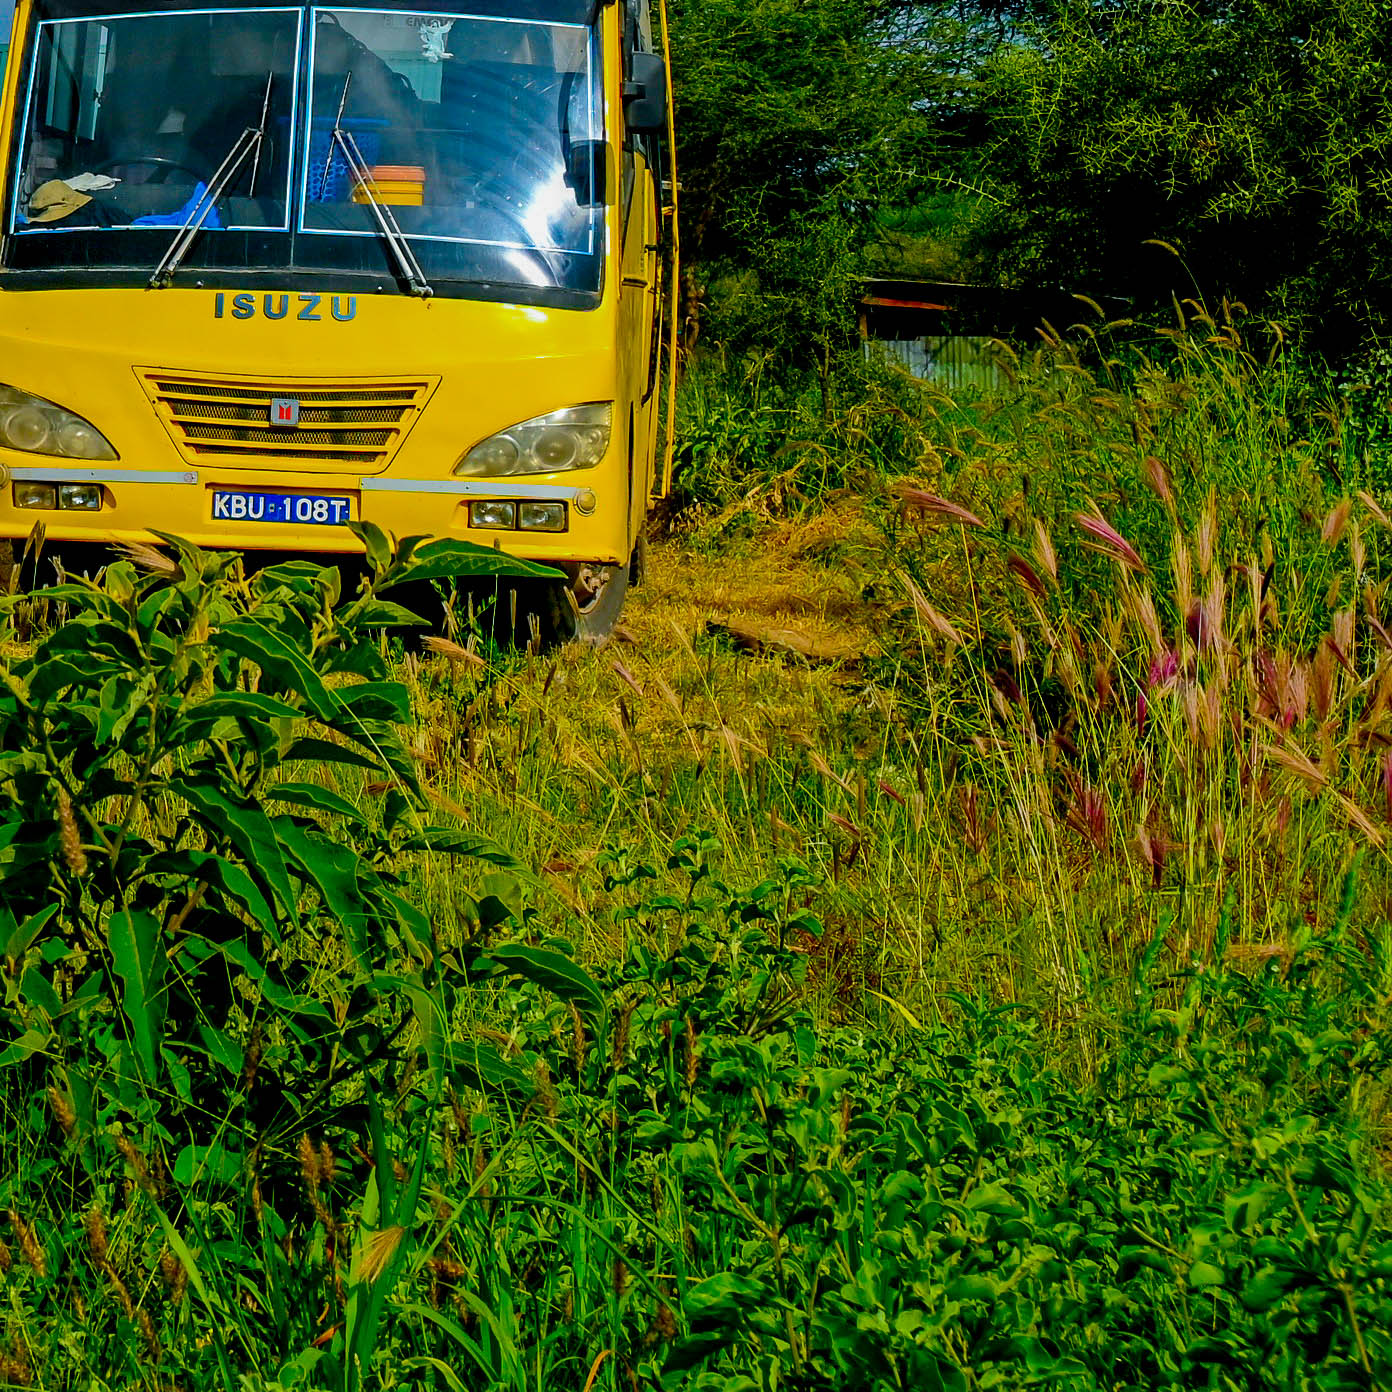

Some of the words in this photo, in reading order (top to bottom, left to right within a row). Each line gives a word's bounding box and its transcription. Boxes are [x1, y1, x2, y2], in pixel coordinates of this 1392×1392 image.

[214, 292, 357, 322] ISUZU
[214, 493, 265, 519] KBU
[283, 497, 347, 523] 108T
